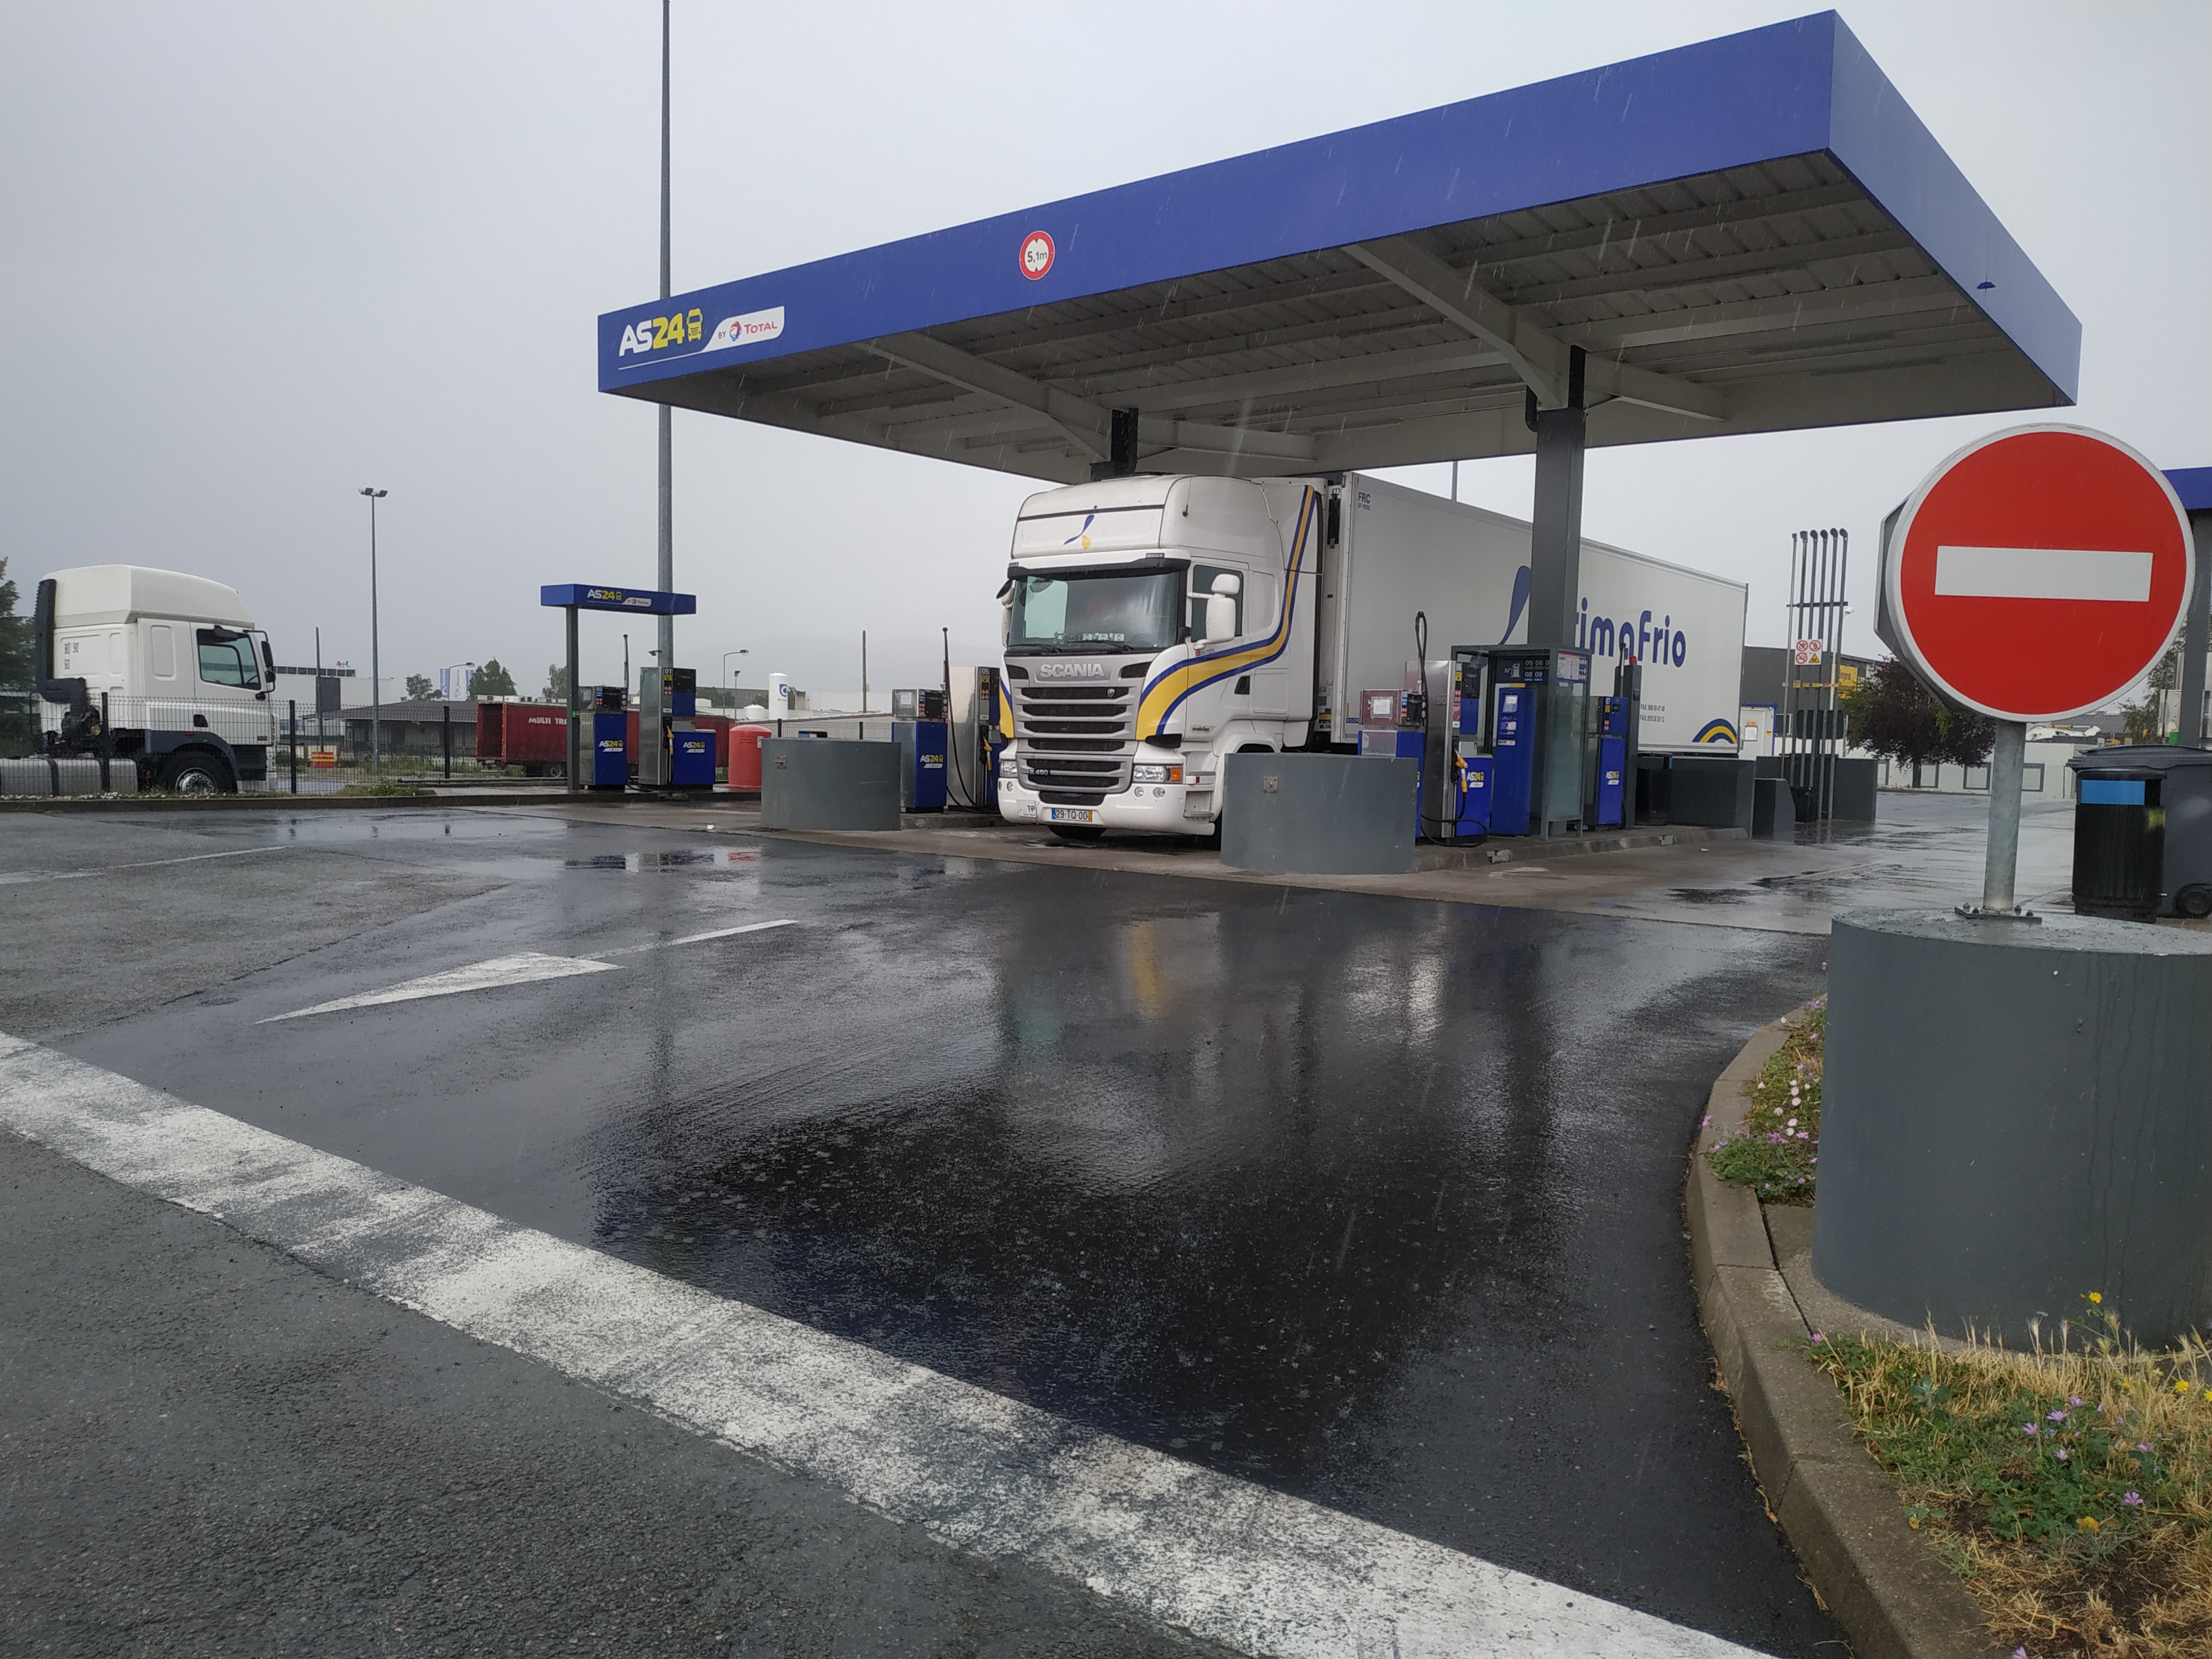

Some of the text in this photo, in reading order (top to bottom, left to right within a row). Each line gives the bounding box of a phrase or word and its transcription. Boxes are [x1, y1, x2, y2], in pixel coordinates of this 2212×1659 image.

[1027, 251, 1048, 264] 5,1m
[618, 312, 685, 357] AS24
[718, 321, 778, 339] BY TOTAL
[1358, 492, 1371, 504] FRC
[587, 588, 615, 601] AS24
[1040, 664, 1105, 678] SCANIA
[1456, 663, 1462, 671] 06
[920, 754, 939, 763] AS24
[1467, 771, 1480, 781] AS24
